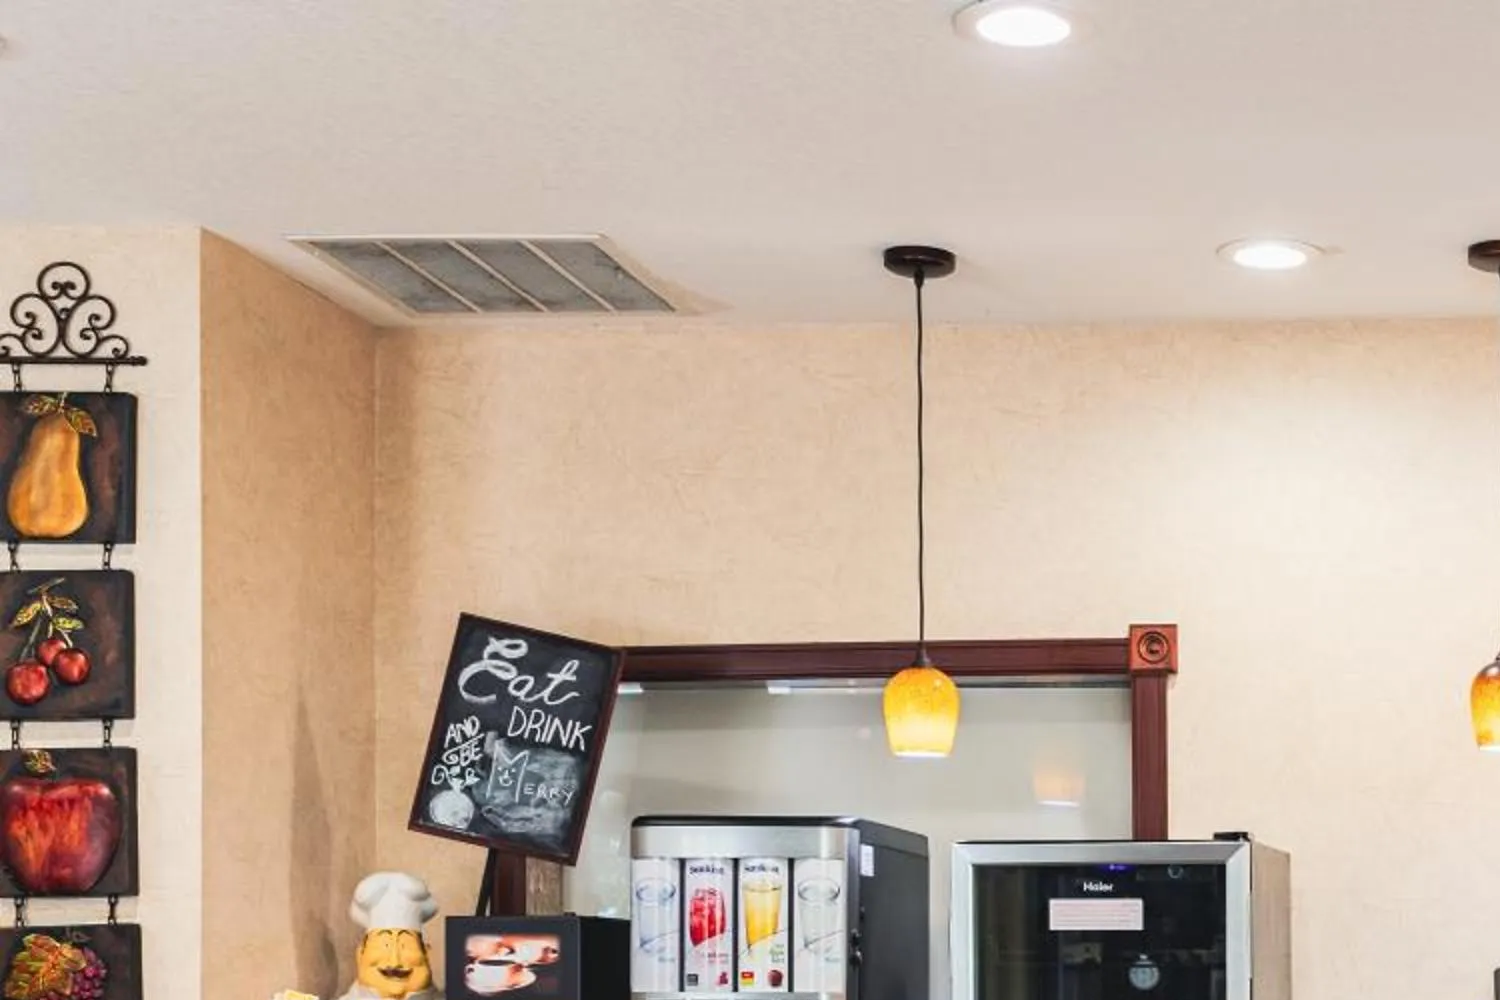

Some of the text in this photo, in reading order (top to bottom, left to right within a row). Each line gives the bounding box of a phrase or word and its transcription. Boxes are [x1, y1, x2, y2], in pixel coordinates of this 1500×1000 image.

[458, 636, 580, 705] Eat
[443, 715, 481, 749] AND
[507, 705, 592, 751] DRINK
[1083, 881, 1114, 892] Haier
